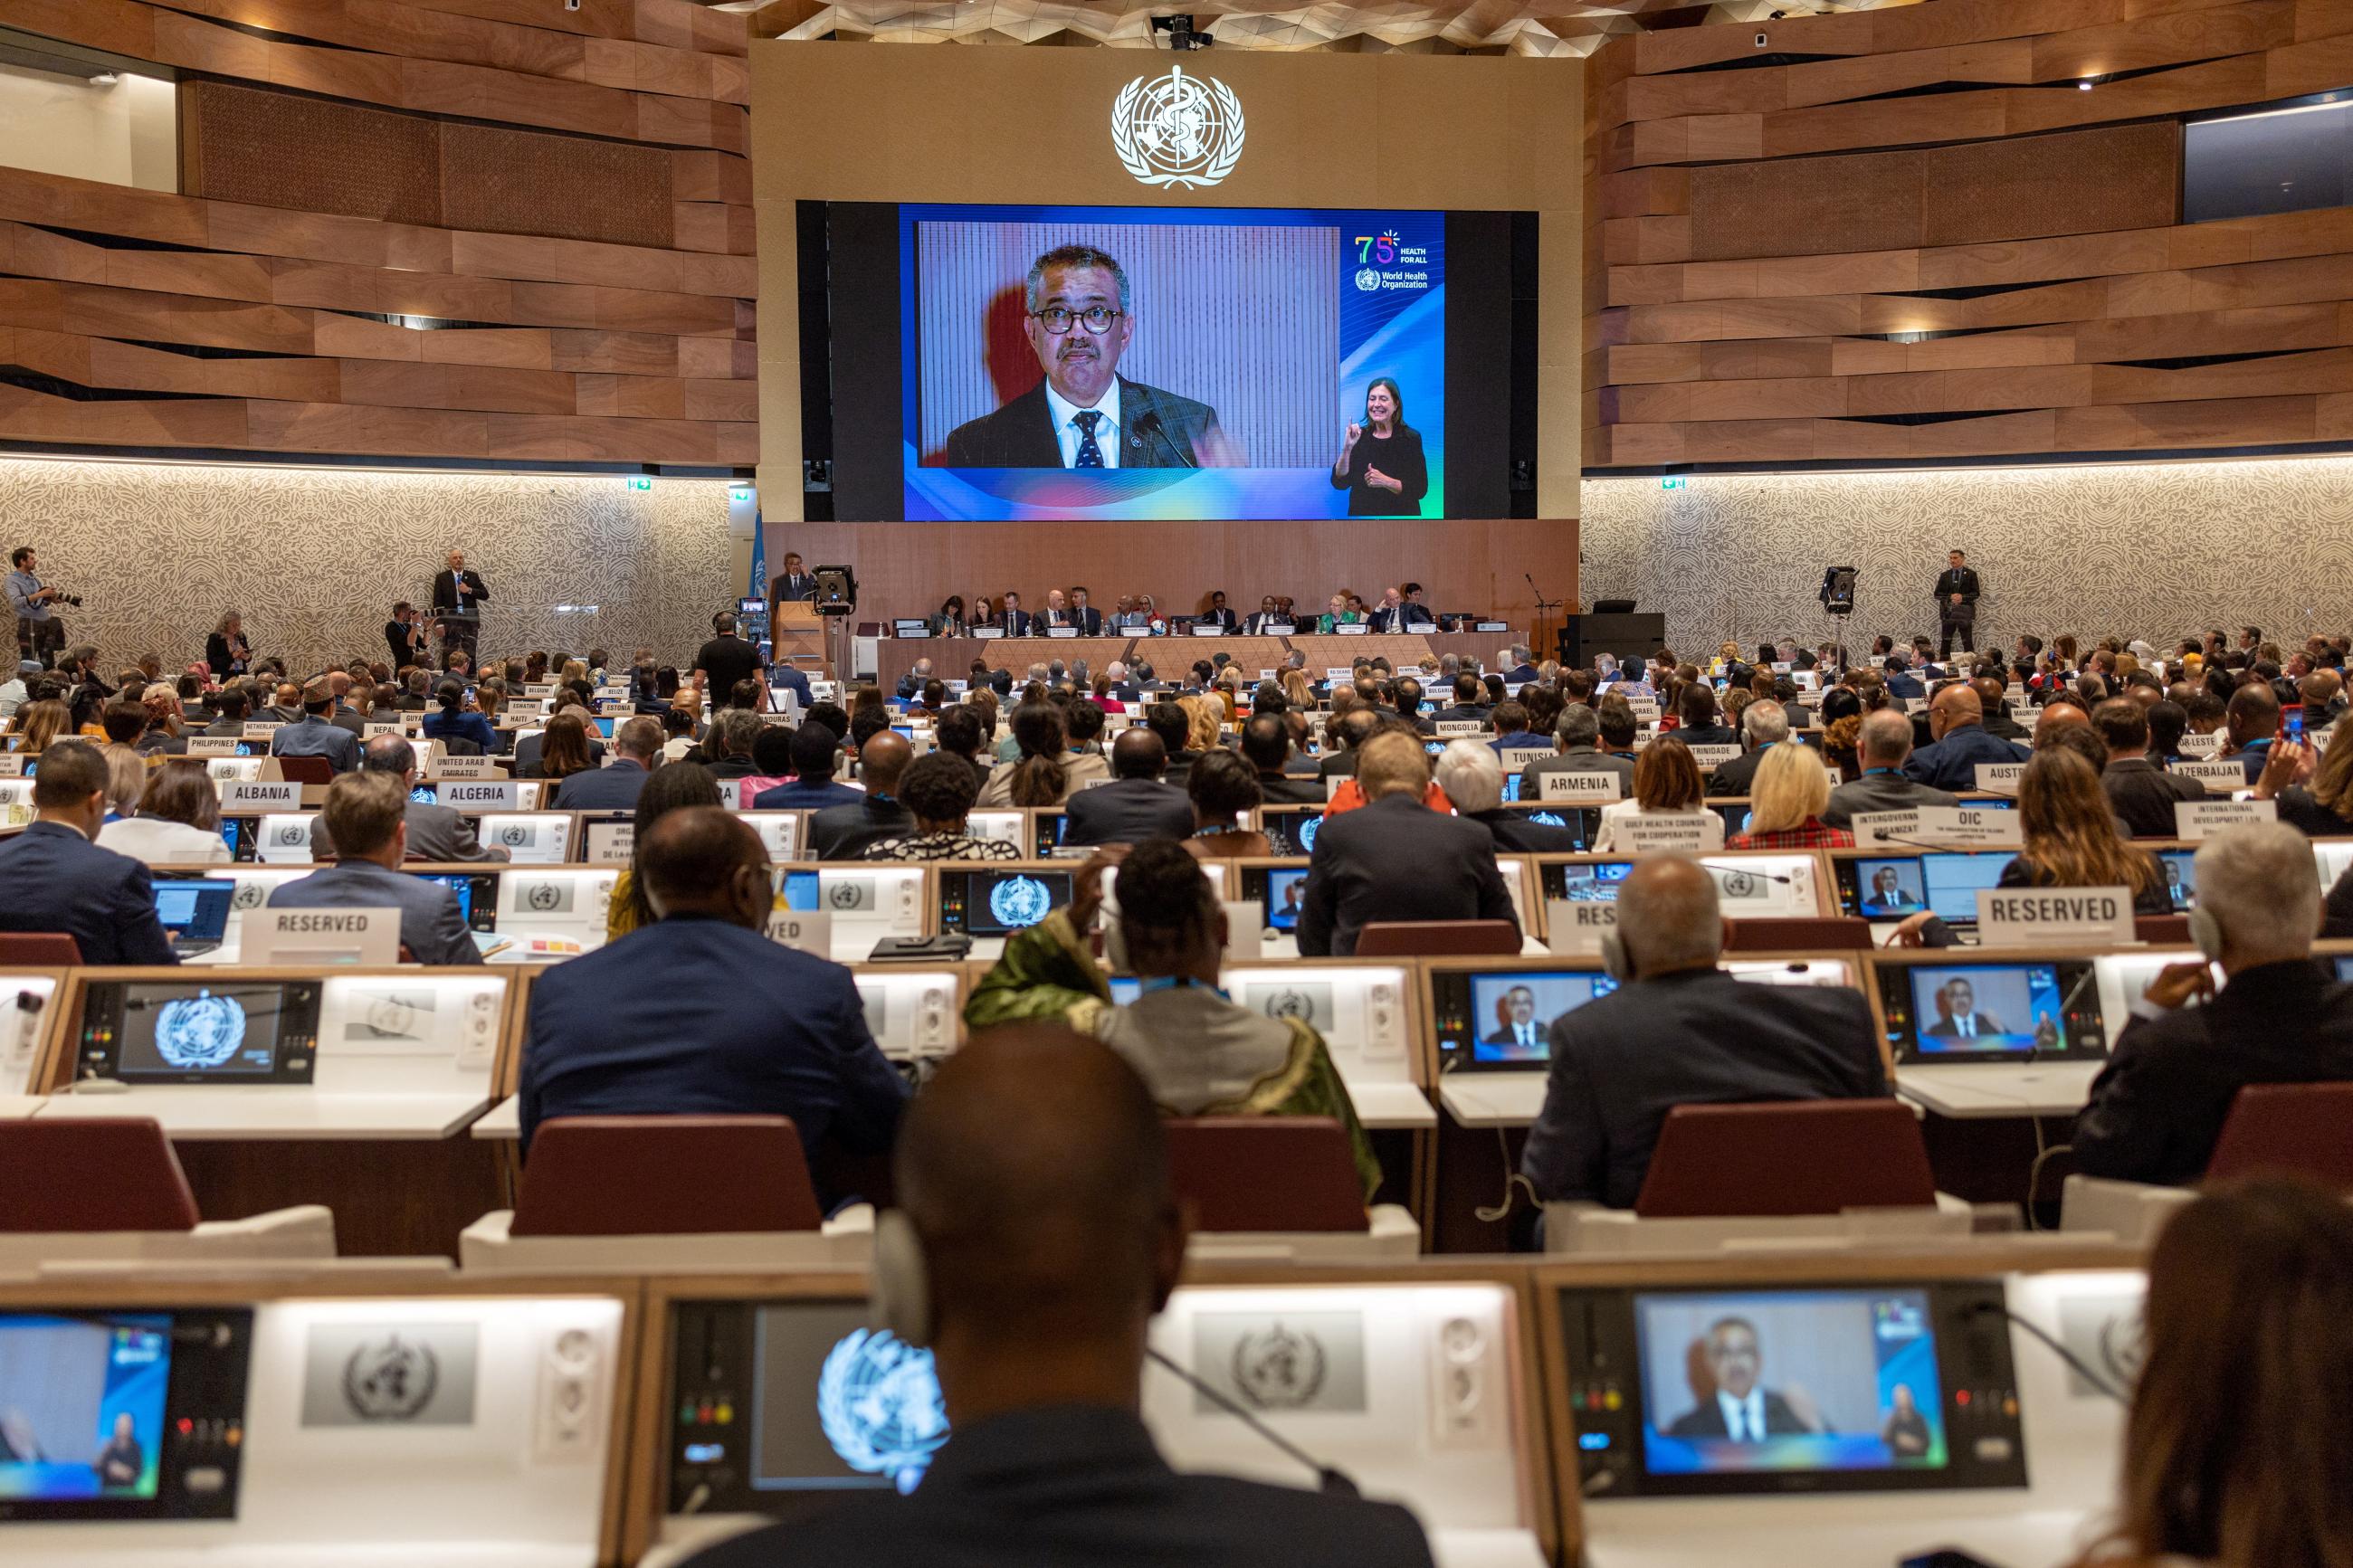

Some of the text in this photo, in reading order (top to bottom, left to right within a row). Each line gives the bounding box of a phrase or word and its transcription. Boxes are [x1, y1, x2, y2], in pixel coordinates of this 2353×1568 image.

[1355, 236, 1394, 263] 75
[1382, 271, 1427, 280] World Health
[1382, 280, 1427, 290] Organization
[374, 726, 395, 734] NEPAL
[1439, 724, 1479, 732] MONGOLIA
[192, 739, 235, 747] PHILIPPINES
[2179, 737, 2215, 746] OR-LESTE
[1692, 746, 1730, 755] TRINIDADE
[437, 758, 485, 766] UNITED ARAB
[442, 769, 479, 777] EMIRATES
[2178, 765, 2241, 777] AZERBAIJAN
[1550, 777, 1609, 791] ARMENIA
[235, 786, 291, 800] ALBANIA
[450, 787, 504, 801] ALGERIA
[2197, 804, 2253, 813] INTERNATIONAL
[1958, 812, 1982, 825] OIC
[2193, 815, 2243, 824] DEVELOPMENT
[1625, 820, 1643, 829] GULF
[1644, 819, 1673, 828] HEALTH
[1633, 831, 1700, 840] FOR COOPERATION
[1991, 897, 2118, 922] RESERVED
[277, 914, 368, 932] RESERVED
